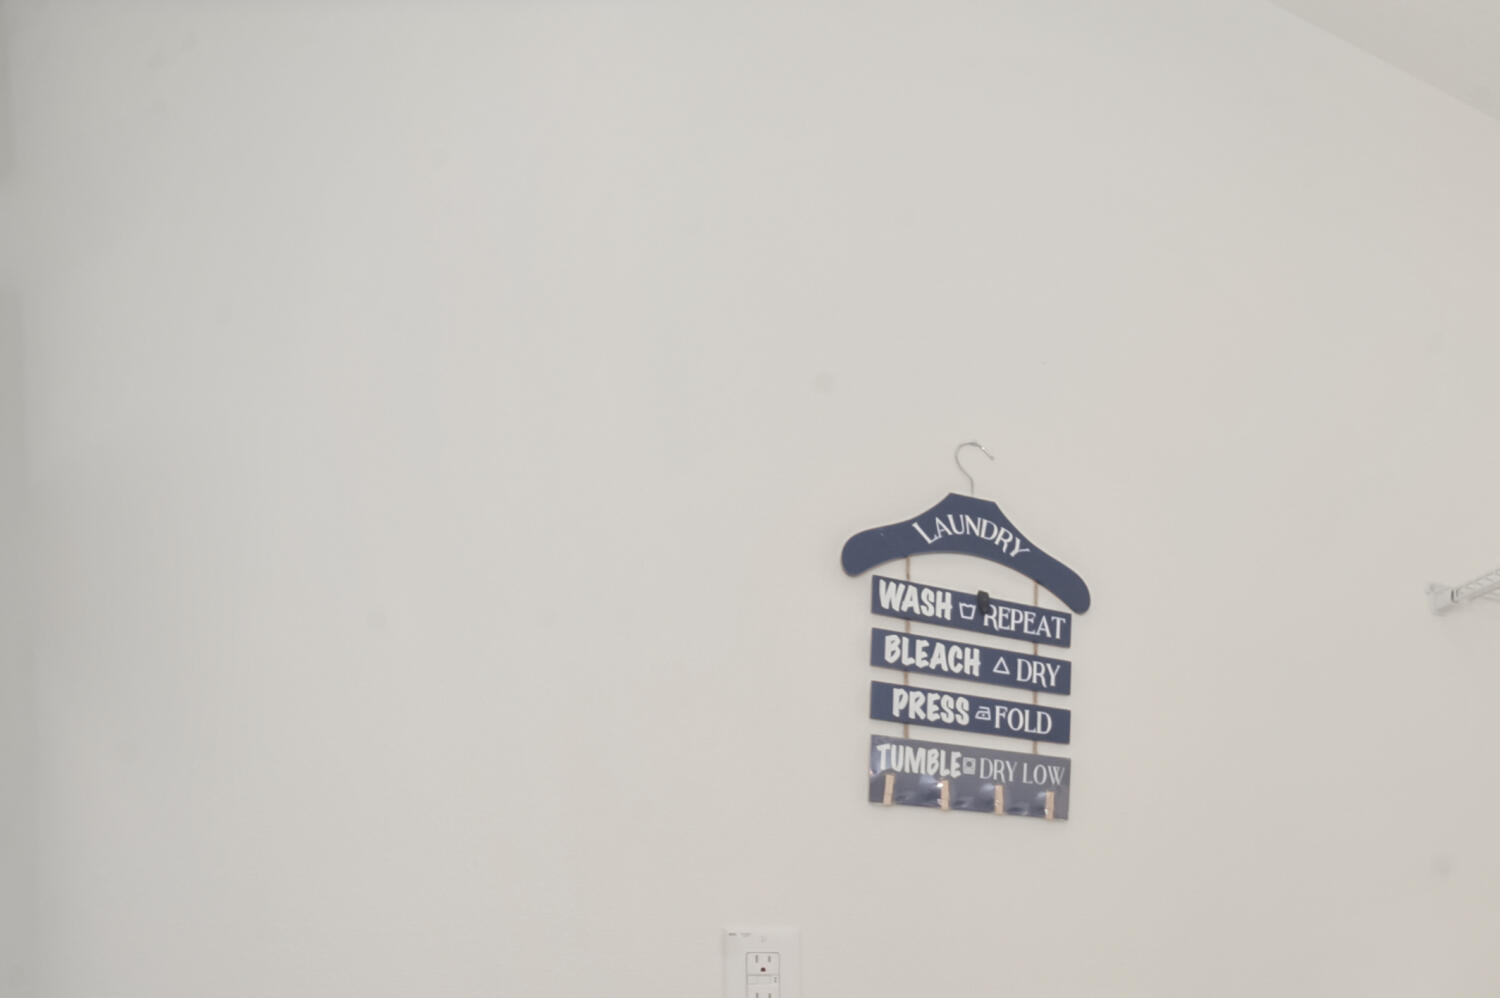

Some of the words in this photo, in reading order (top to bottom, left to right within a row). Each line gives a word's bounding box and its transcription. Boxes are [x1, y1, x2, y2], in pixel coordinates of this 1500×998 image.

[912, 514, 1030, 557] LAUNDRY
[879, 579, 953, 620] WASH
[984, 604, 1066, 640] REPEAT
[884, 634, 981, 677] BLEACH
[1016, 658, 1061, 688] DRY
[892, 687, 970, 726] PRESS
[994, 705, 1052, 735] FOLD
[876, 743, 962, 778] TUMBLE
[979, 757, 1018, 783] DRY
[1022, 763, 1065, 785] LOW
